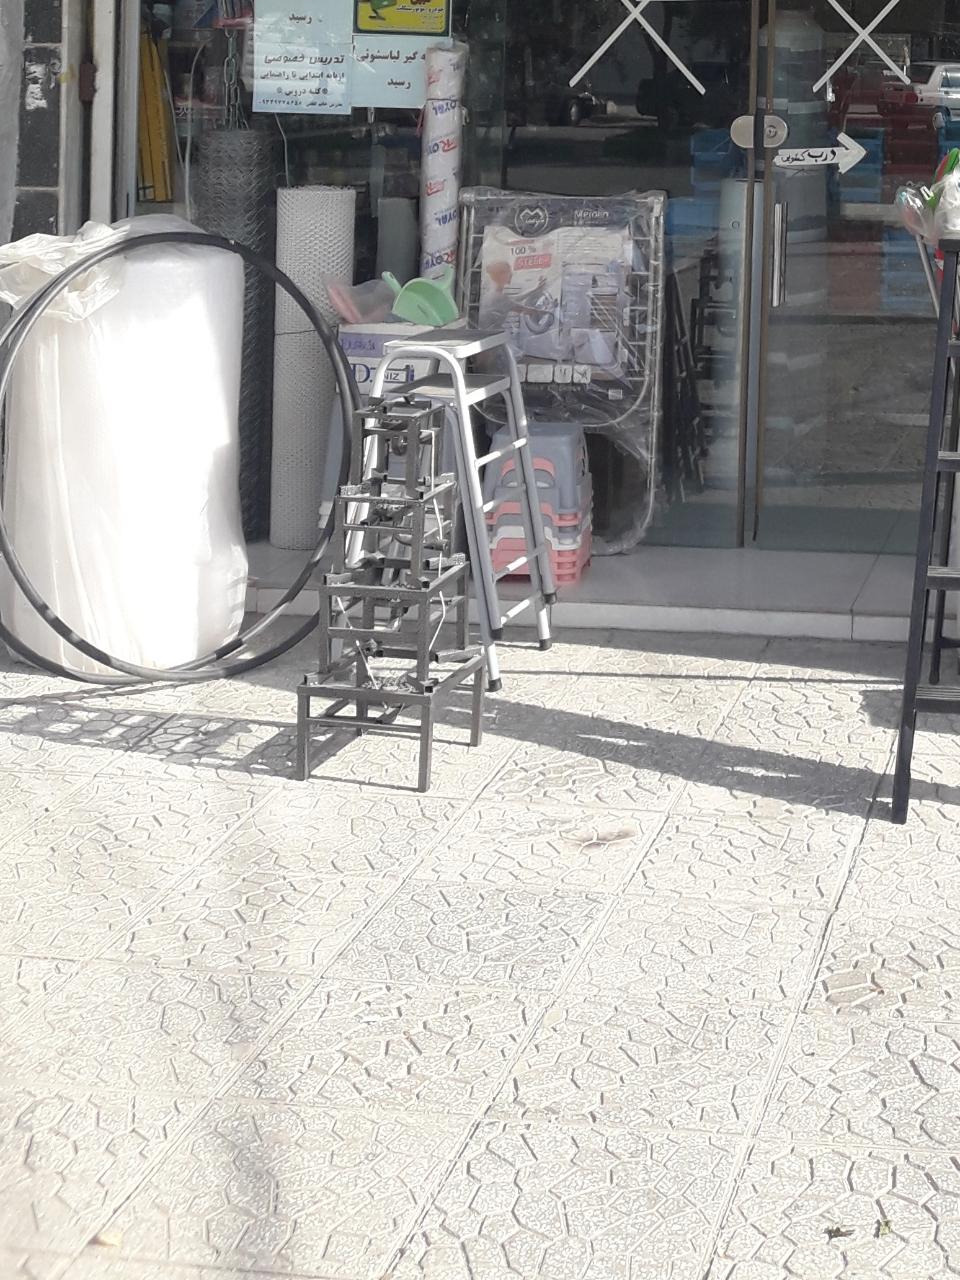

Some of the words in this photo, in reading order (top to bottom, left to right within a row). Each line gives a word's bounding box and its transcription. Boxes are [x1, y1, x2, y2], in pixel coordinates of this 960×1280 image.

[289, 13, 313, 24] رسید
[264, 53, 305, 64] خصوصی
[309, 55, 345, 66] تدریس
[387, 78, 411, 90] رسید
[807, 148, 837, 163] درب
[511, 247, 526, 256] 100
